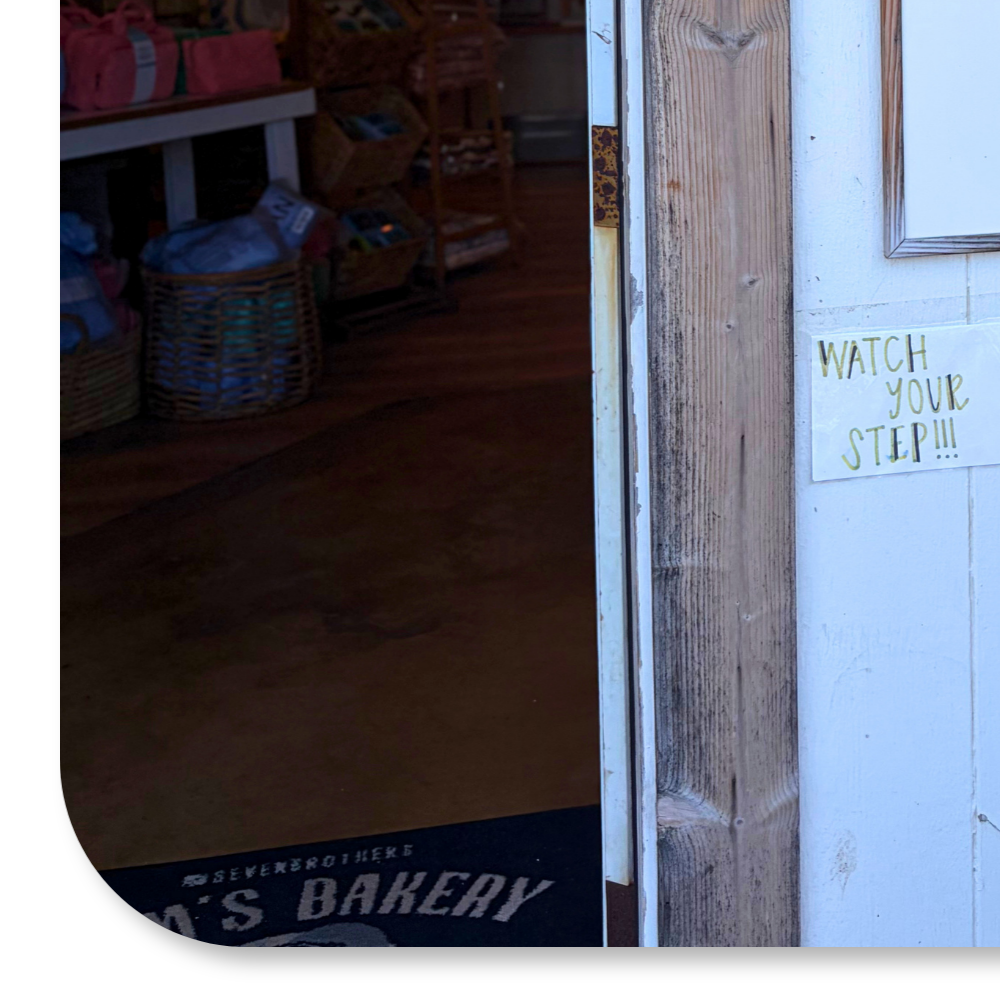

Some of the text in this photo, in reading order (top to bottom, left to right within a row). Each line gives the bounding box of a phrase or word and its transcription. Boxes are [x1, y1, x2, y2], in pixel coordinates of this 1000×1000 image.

[817, 333, 928, 380] WATCH
[886, 374, 969, 419] YOUR
[841, 417, 959, 471] STEP!!!
[296, 871, 556, 922] BAKERY
